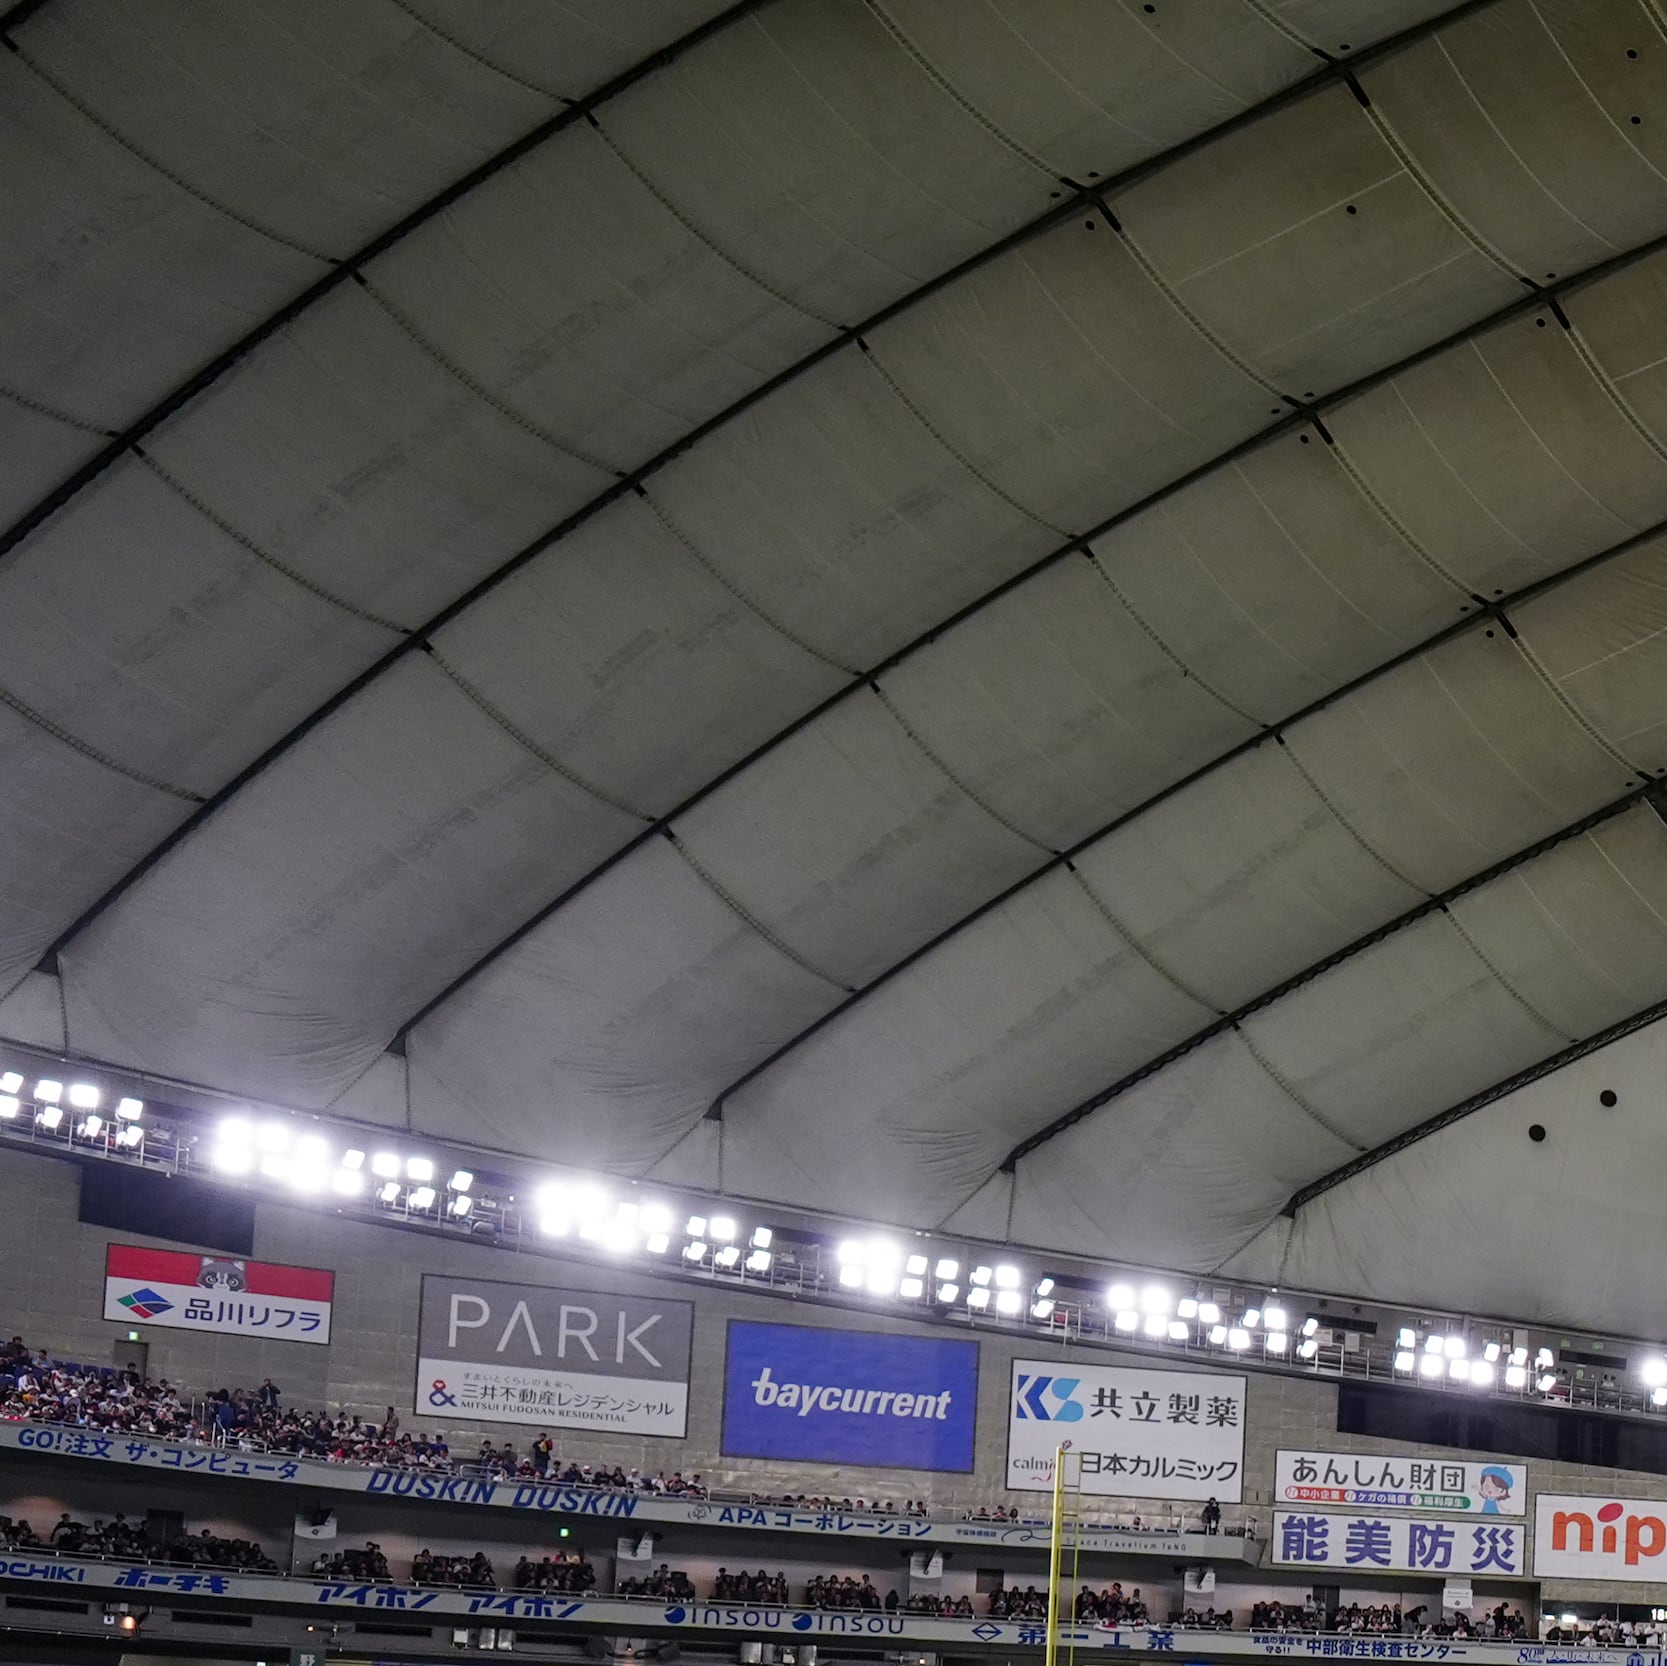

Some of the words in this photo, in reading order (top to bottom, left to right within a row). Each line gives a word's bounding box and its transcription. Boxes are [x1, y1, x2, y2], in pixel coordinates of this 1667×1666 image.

[185, 1297, 321, 1333] 品川リフラ
[448, 1294, 663, 1369] PARK
[460, 1401, 499, 1412] MITSUI
[502, 1404, 556, 1417] FUDOSAN
[558, 1410, 628, 1423] RESIDENTIAL
[461, 1383, 675, 1417] 三井不動産レジデンシャル
[752, 1367, 951, 1421] baycurrent
[1090, 1387, 1240, 1428] 共立製薬
[126, 1441, 301, 1481] ザ・コンピュータ
[1081, 1451, 1238, 1482] 日本カルミック
[1293, 1457, 1466, 1493] あんしん財団
[718, 1506, 768, 1526] APA
[774, 1512, 932, 1537] コーポレーション
[1281, 1515, 1516, 1573] 能美防災
[114, 1567, 231, 1595] ホーチキ
[1306, 1637, 1467, 1659] 中部衛生検査センター
